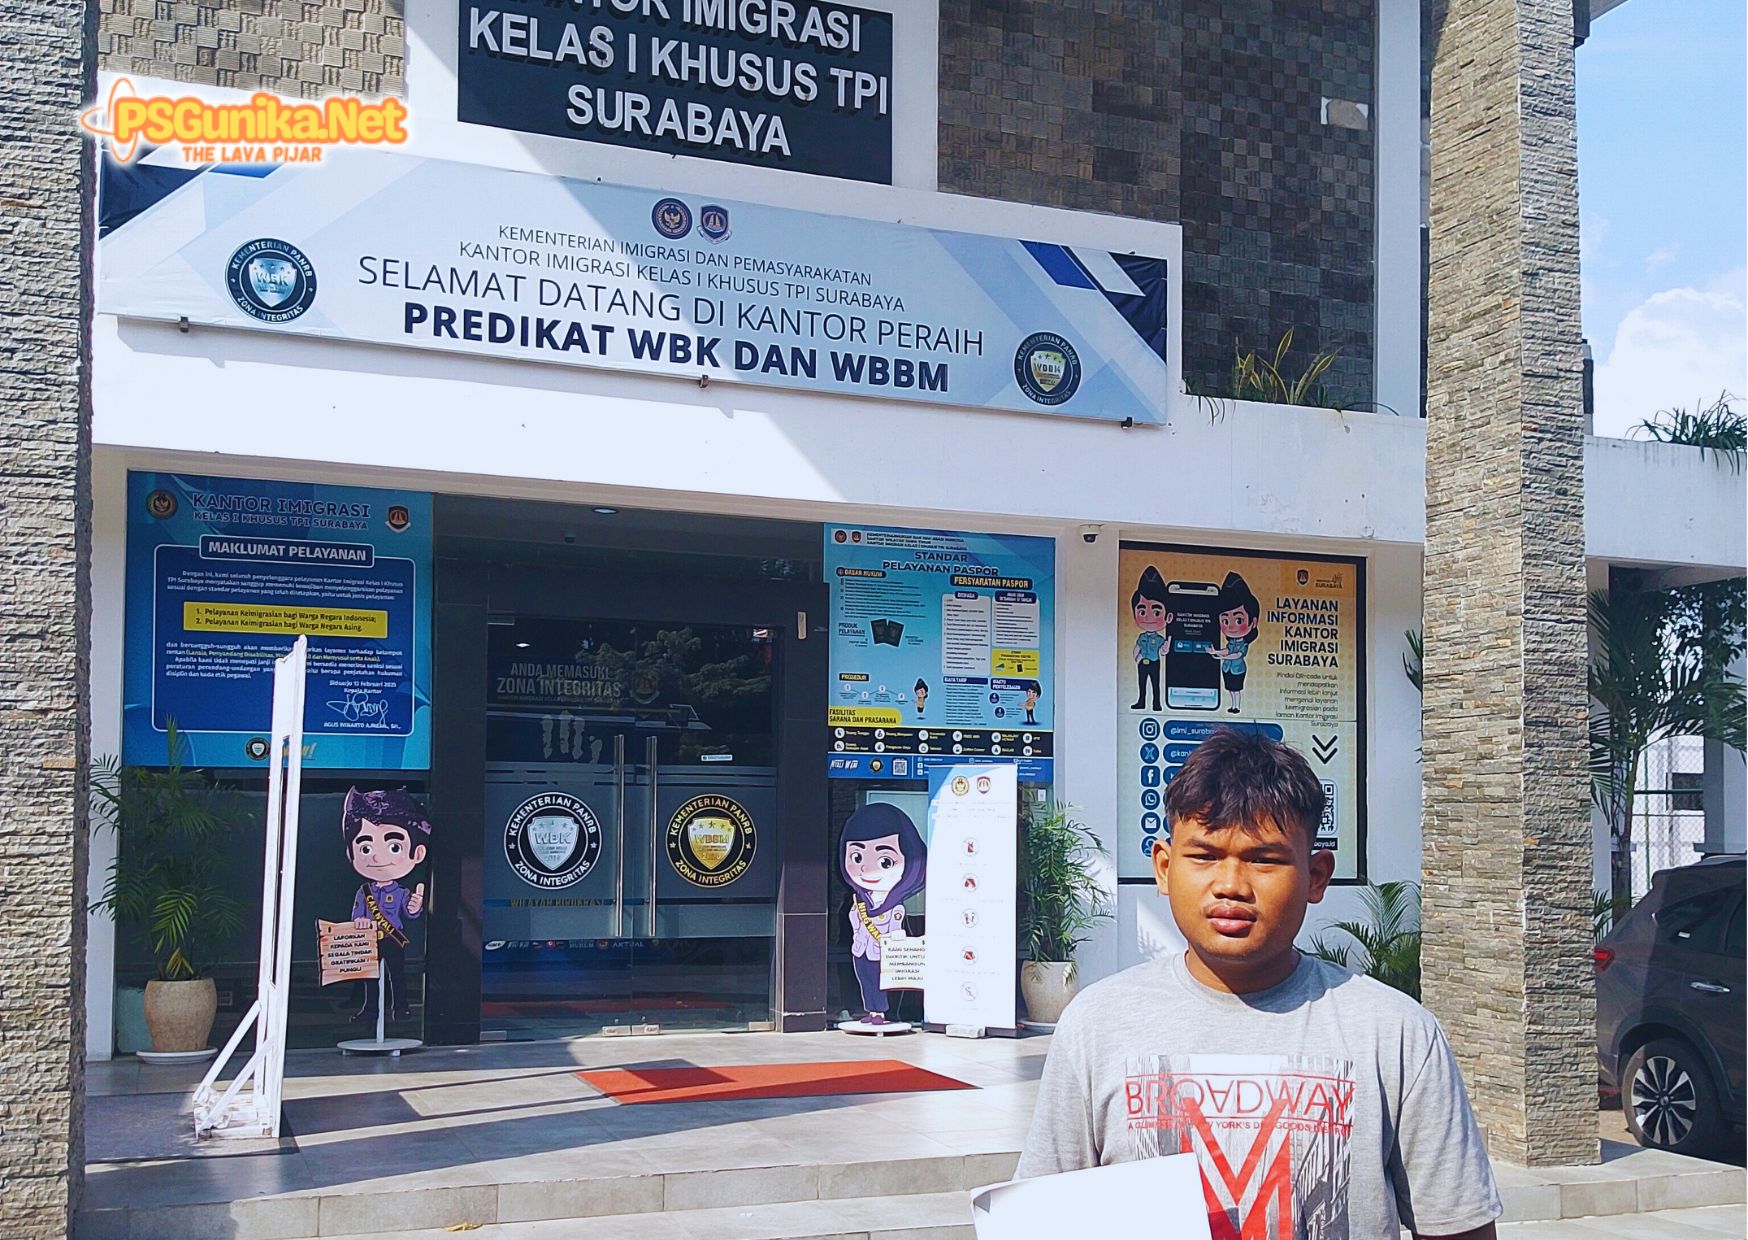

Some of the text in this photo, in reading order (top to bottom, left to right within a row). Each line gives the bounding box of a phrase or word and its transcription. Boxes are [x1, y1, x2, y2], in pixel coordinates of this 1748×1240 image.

[683, 0, 860, 52] IMIGRASI
[469, 8, 887, 114] KELAS I KHUSUS TPI
[567, 85, 791, 156] SURABAYA
[232, 240, 312, 277] KEMENTERIAN PANRB
[499, 225, 871, 286] KEMENTERIAN IMIGRASI DAN PEMASYARAKATAN
[460, 241, 904, 312] KANTOR IMIGRASI KELAS I KHUSUS TPI SURABAYA
[237, 296, 304, 322] ZONA INTEGRITAS
[358, 256, 983, 356] SELAMAT DATANG DI KANTOR PERAIH
[404, 302, 948, 392] PREDIKAT WBK DAN WBBM
[1022, 384, 1036, 400] ZONA
[192, 493, 370, 518] KANTOR IMIGRASI
[194, 511, 368, 530] KELAS I KHUSUS TPI SURABAYA
[209, 541, 366, 561] MAKLUMAT PELAYANAN
[914, 551, 968, 562] STANDAR
[883, 562, 998, 576] PELAYANAN PASPOR
[954, 576, 1028, 588] PERSYARATAN PASPOR
[204, 608, 238, 618] Pelayanan
[284, 612, 298, 620] bagi
[299, 613, 318, 621] Warga
[320, 613, 342, 622] Negara
[1276, 598, 1338, 612] LAYANAN
[204, 618, 238, 628] Pelayanan
[284, 621, 298, 630] bagi
[300, 622, 319, 630] Warga
[320, 623, 342, 632] Negara
[1267, 611, 1338, 626] INFORMASI
[1284, 626, 1338, 640] KANTOR
[1280, 640, 1338, 654] IMIGRASI
[510, 662, 543, 676] ANDA
[1268, 654, 1338, 668] SURABAYA
[496, 677, 622, 698] ZONA INTEGRITAS
[508, 796, 597, 836] KEMENTERIAN PANRB
[670, 798, 752, 836] KEMENTERIAN PANRB
[534, 832, 572, 844] WBK
[514, 860, 590, 886] ZONA INTEGRITAS
[675, 860, 747, 884] ZONA INTEGRITAS
[366, 896, 395, 934] CAK NYALI
[858, 902, 872, 925] NING
[1126, 1078, 1355, 1118] BROADWAY
